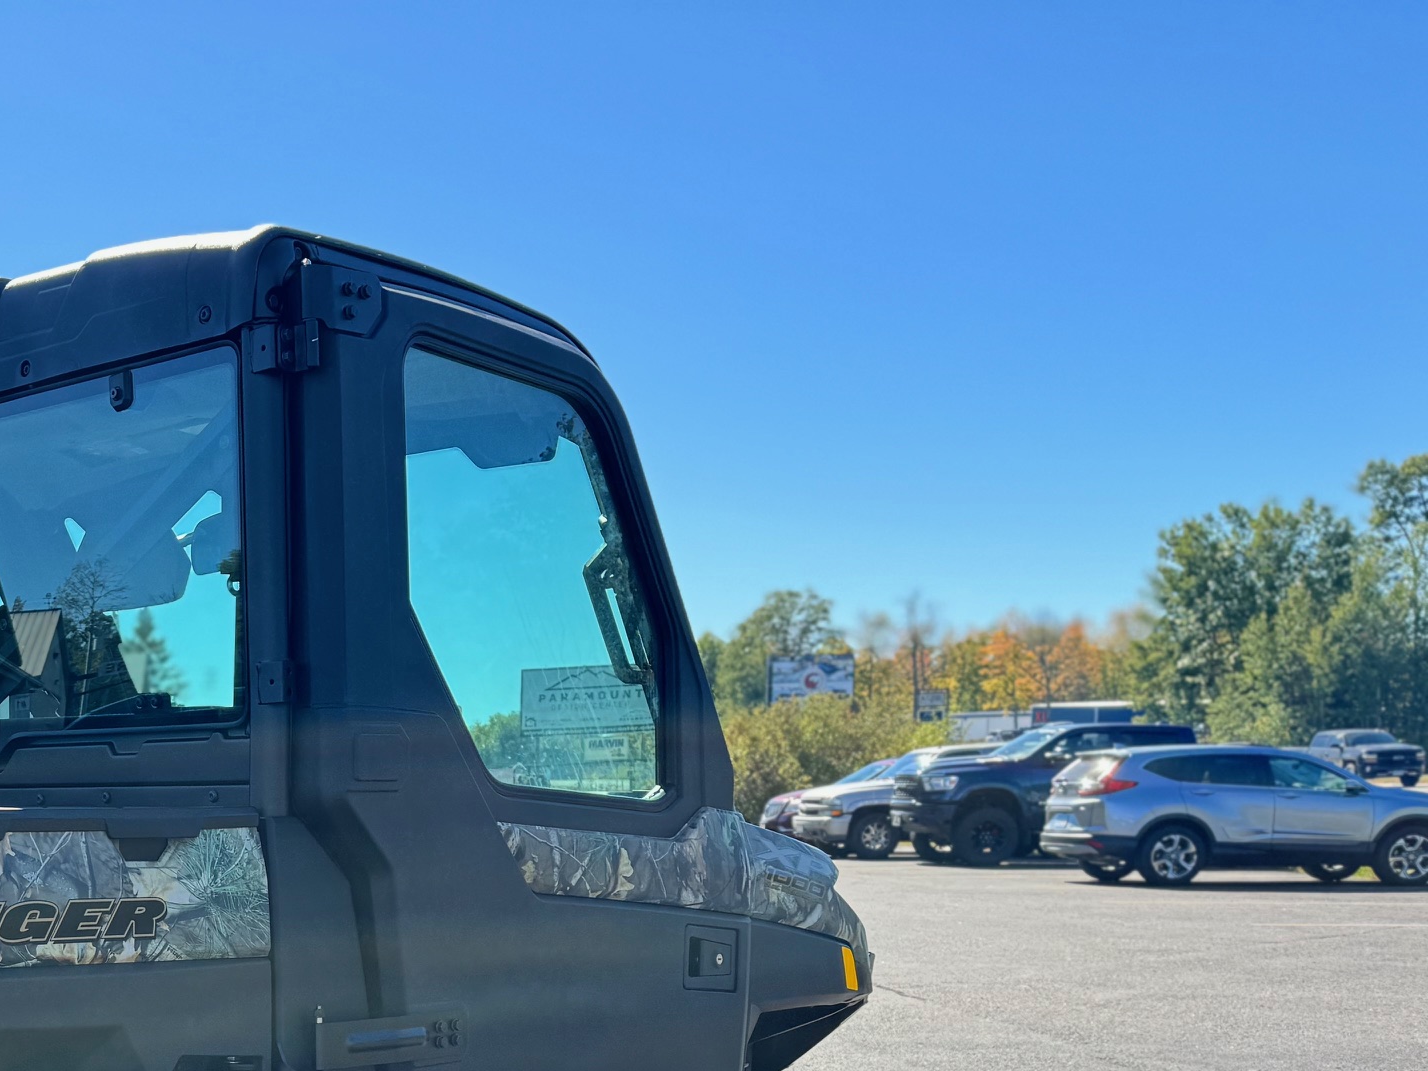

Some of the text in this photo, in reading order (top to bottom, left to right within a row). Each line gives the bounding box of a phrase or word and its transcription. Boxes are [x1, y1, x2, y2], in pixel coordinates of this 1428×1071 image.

[539, 689, 644, 703] PARAMOUNT
[756, 834, 834, 879] XP
[766, 865, 826, 899] 1000
